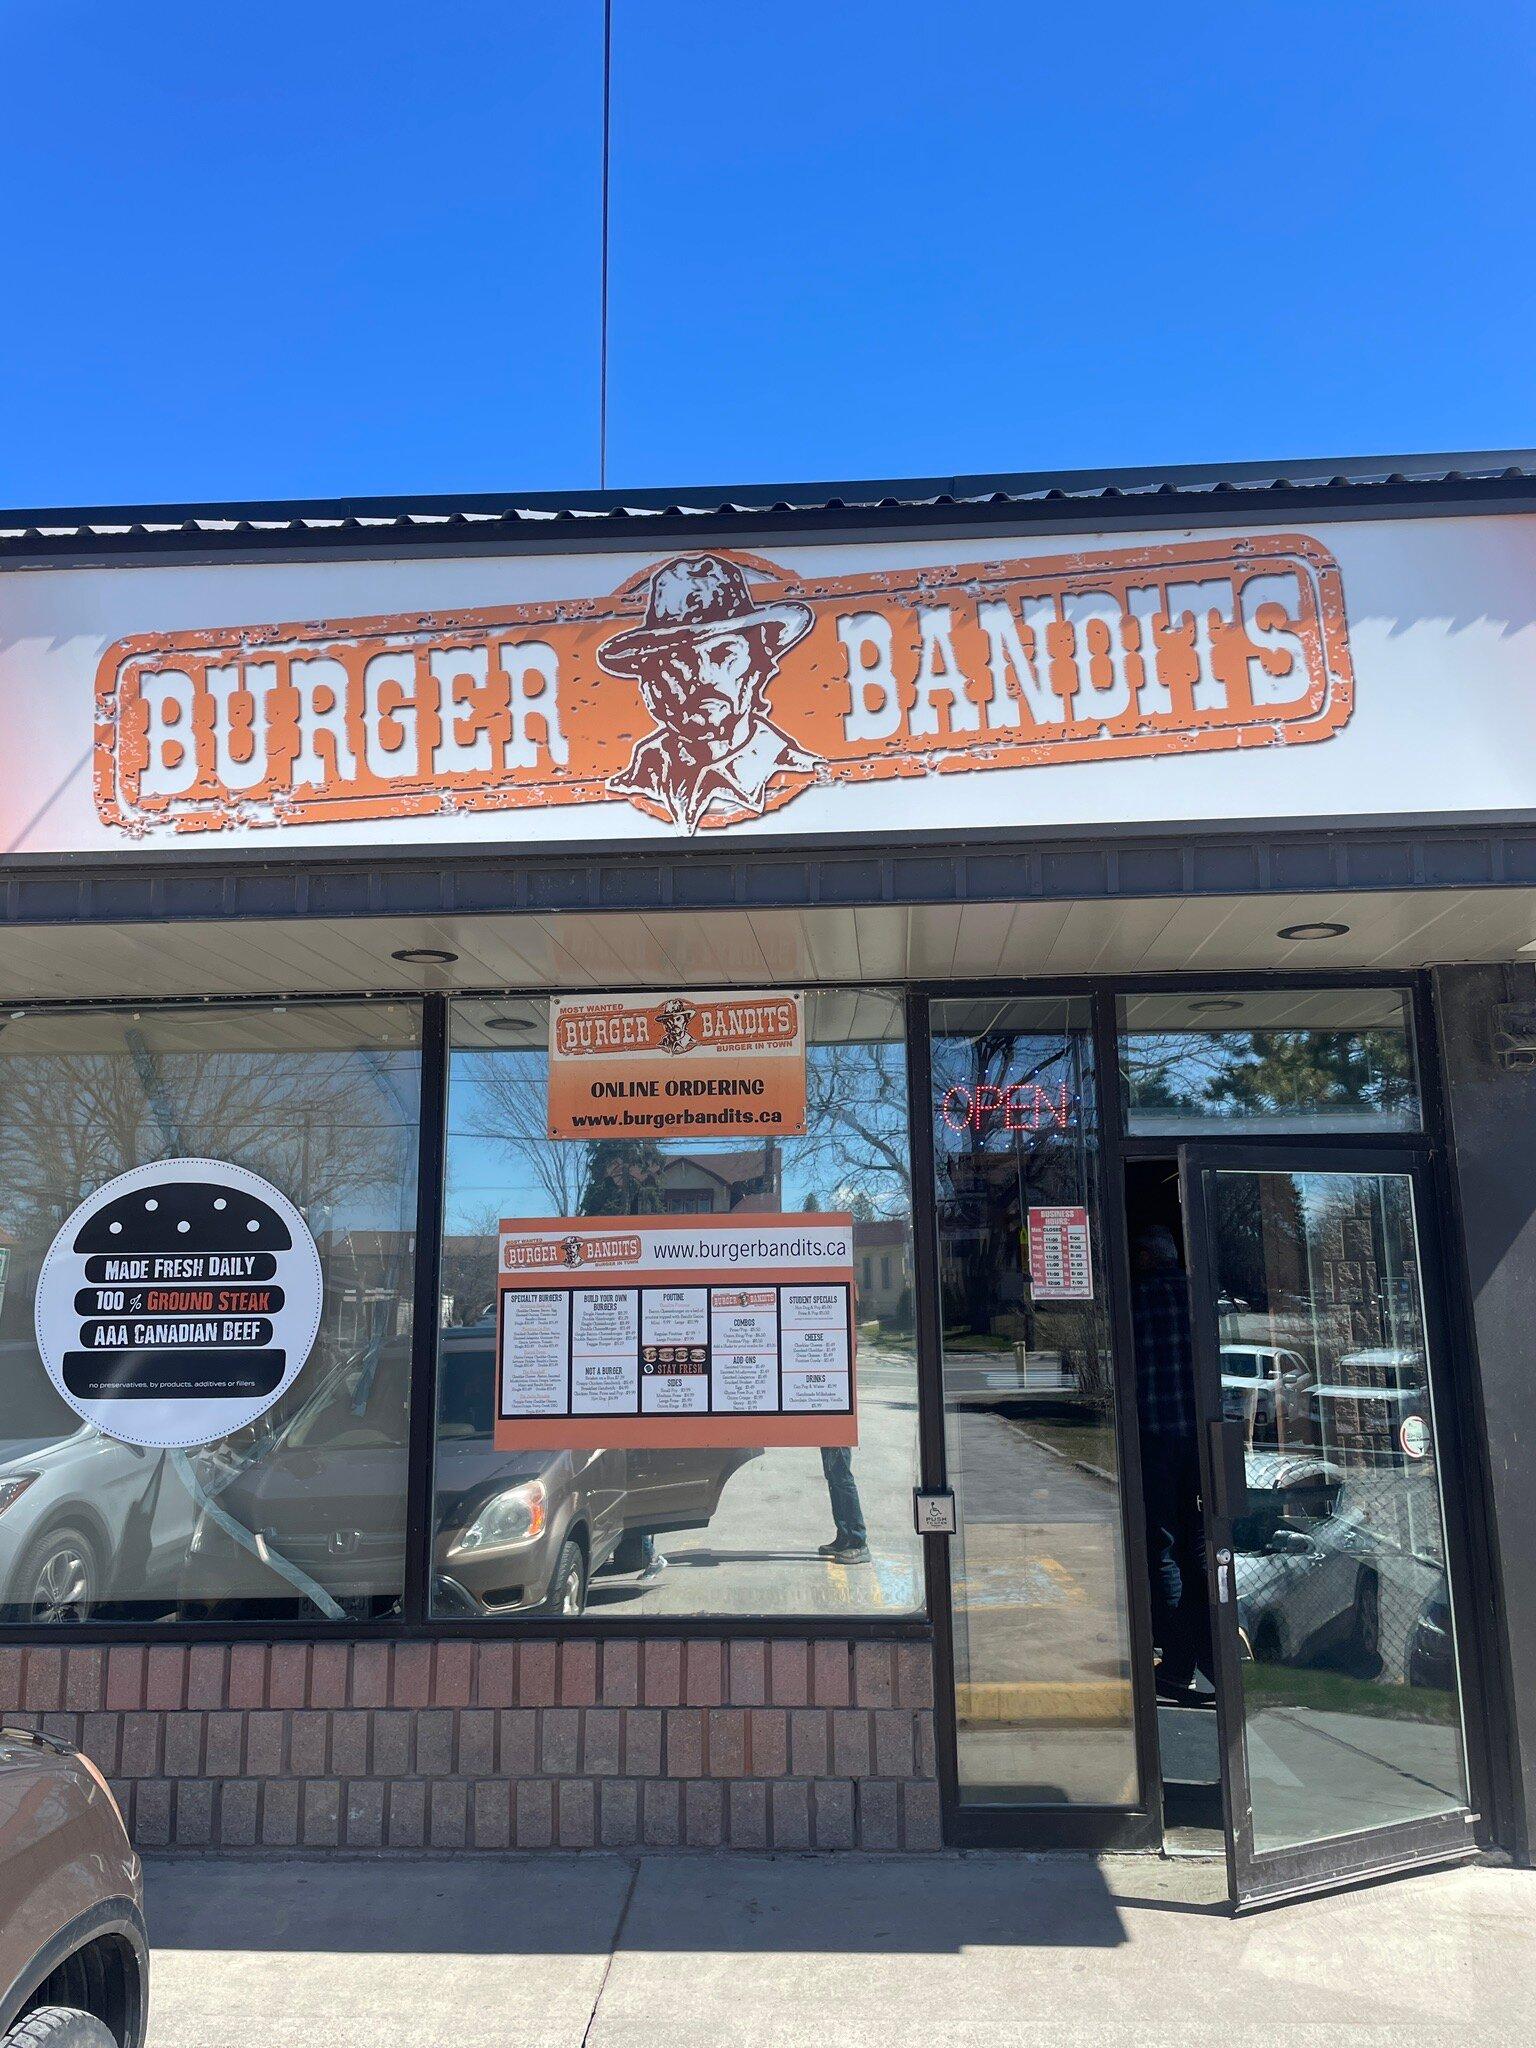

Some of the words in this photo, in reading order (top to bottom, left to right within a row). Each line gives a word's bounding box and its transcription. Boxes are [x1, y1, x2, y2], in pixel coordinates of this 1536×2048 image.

[138, 640, 569, 799] BURGER
[835, 573, 1313, 742] BANDITS
[560, 1005, 584, 1014] MOST
[587, 1003, 624, 1012] WANTED
[565, 1016, 649, 1048] BURGER
[701, 1005, 790, 1038] BANDITS
[716, 1043, 753, 1053] BURGER
[755, 1042, 765, 1050] IN
[767, 1040, 793, 1049] TOWN
[590, 1080, 660, 1098] ONLINE
[665, 1078, 765, 1097] ORDERING
[943, 1083, 1067, 1130] OPEN
[572, 1108, 782, 1129] www.burgerbandits.ca
[1041, 1210, 1074, 1218] BUSINESS
[509, 1245, 558, 1264] BURGER
[586, 1239, 637, 1259] BANDITS
[654, 1239, 846, 1262] www.burgerbandits.ca
[105, 1260, 149, 1280] MADE
[154, 1258, 204, 1279] FRESH
[209, 1256, 256, 1277] DAILY
[96, 1290, 124, 1311] 100
[129, 1293, 142, 1313] %
[147, 1290, 213, 1311] GROUND
[218, 1291, 271, 1311] STEAK
[539, 1294, 562, 1302] BURGERS
[615, 1294, 627, 1302] OWN
[663, 1293, 684, 1301] POUTINE
[789, 1296, 811, 1304] STUDENT
[813, 1295, 837, 1303] SPECIALS
[594, 1303, 617, 1311] BURGERS
[734, 1319, 755, 1327] COMBOS
[94, 1325, 129, 1346] AAA
[134, 1322, 218, 1344] CANADIAN
[223, 1321, 261, 1342] BEEF
[805, 1333, 823, 1341] CHEESE
[733, 1356, 744, 1364] ADD
[746, 1356, 757, 1364] ONS
[585, 1367, 596, 1375] NOT
[597, 1367, 601, 1375] A
[602, 1367, 623, 1375] BURGER
[658, 1364, 676, 1374] STAY
[680, 1363, 703, 1373] FRESH
[150, 1380, 158, 1388] by
[667, 1379, 683, 1387] SIDES
